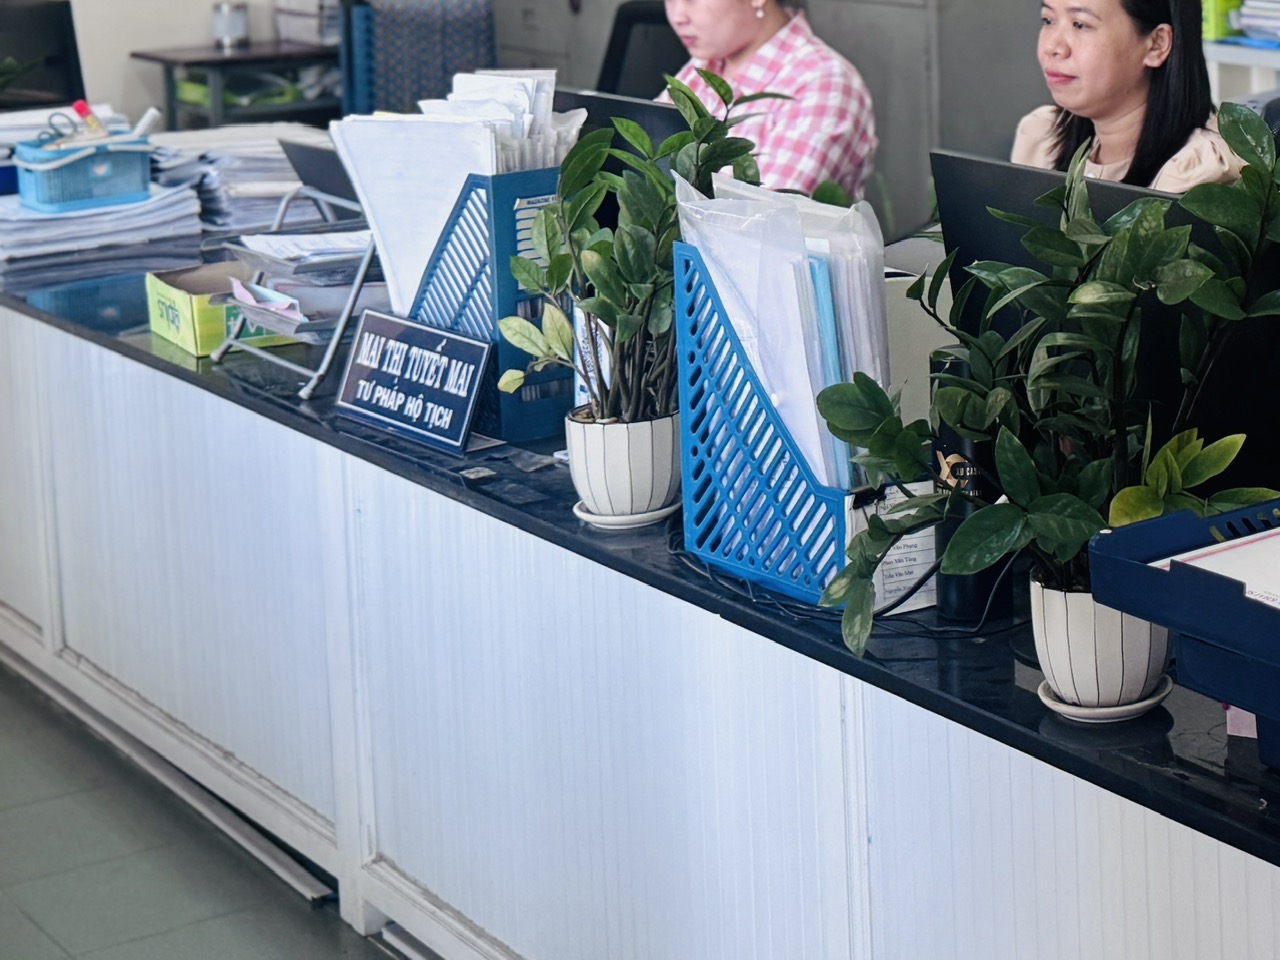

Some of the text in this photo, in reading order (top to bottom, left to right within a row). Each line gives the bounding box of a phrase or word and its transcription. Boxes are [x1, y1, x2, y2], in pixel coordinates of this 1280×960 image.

[356, 332, 475, 397] MAI THỊ TUYẾT MAI
[356, 379, 453, 429] TƯ PHÁP HỘ TỊCH
